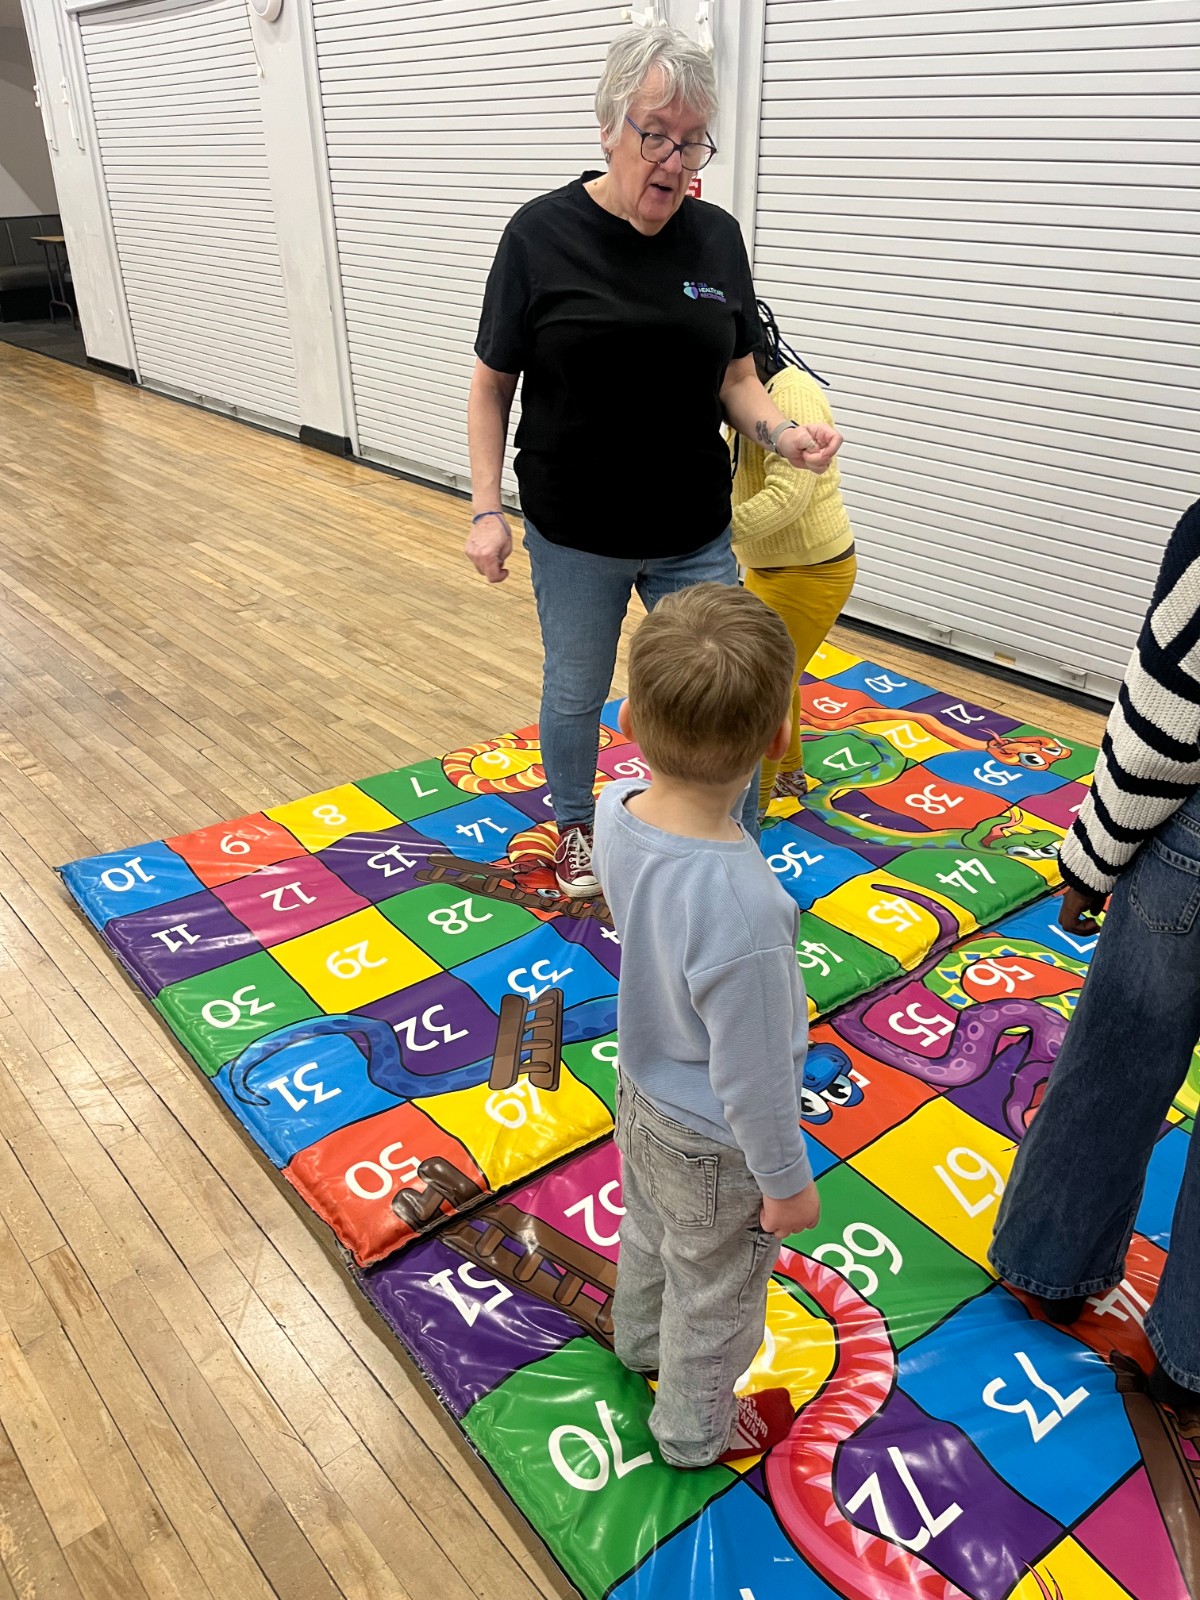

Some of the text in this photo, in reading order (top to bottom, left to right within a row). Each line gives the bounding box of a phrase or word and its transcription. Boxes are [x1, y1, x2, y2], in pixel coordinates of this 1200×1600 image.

[864, 674, 907, 693] 20
[813, 697, 848, 714] 19
[941, 704, 985, 725] 21
[881, 723, 931, 749] 22
[822, 746, 871, 771] 23
[973, 760, 1022, 786] 39
[410, 777, 438, 798] 7
[905, 784, 964, 815] 38
[312, 804, 346, 826] 8
[456, 817, 508, 843] 14
[101, 857, 156, 892] 10
[367, 845, 417, 878] 13
[766, 842, 824, 878] 36
[936, 858, 996, 894] 44
[260, 882, 317, 911] 12
[866, 896, 923, 933] 45
[427, 898, 493, 935] 28
[151, 924, 201, 953] 11
[326, 940, 388, 980] 29
[796, 940, 844, 977] 46
[965, 957, 1035, 993] 56
[507, 959, 574, 1003] 33
[201, 984, 275, 1029] 30
[393, 1004, 469, 1052] 32
[888, 1002, 955, 1048] 55
[267, 1061, 342, 1113] 31
[485, 1077, 542, 1129] 49
[344, 1141, 420, 1200] 50
[934, 1147, 1005, 1218] 67
[811, 1222, 903, 1298] 68
[428, 1262, 514, 1328] 51
[982, 1351, 1090, 1443] 73
[548, 1400, 654, 1492] 70
[844, 1446, 964, 1552] 72
